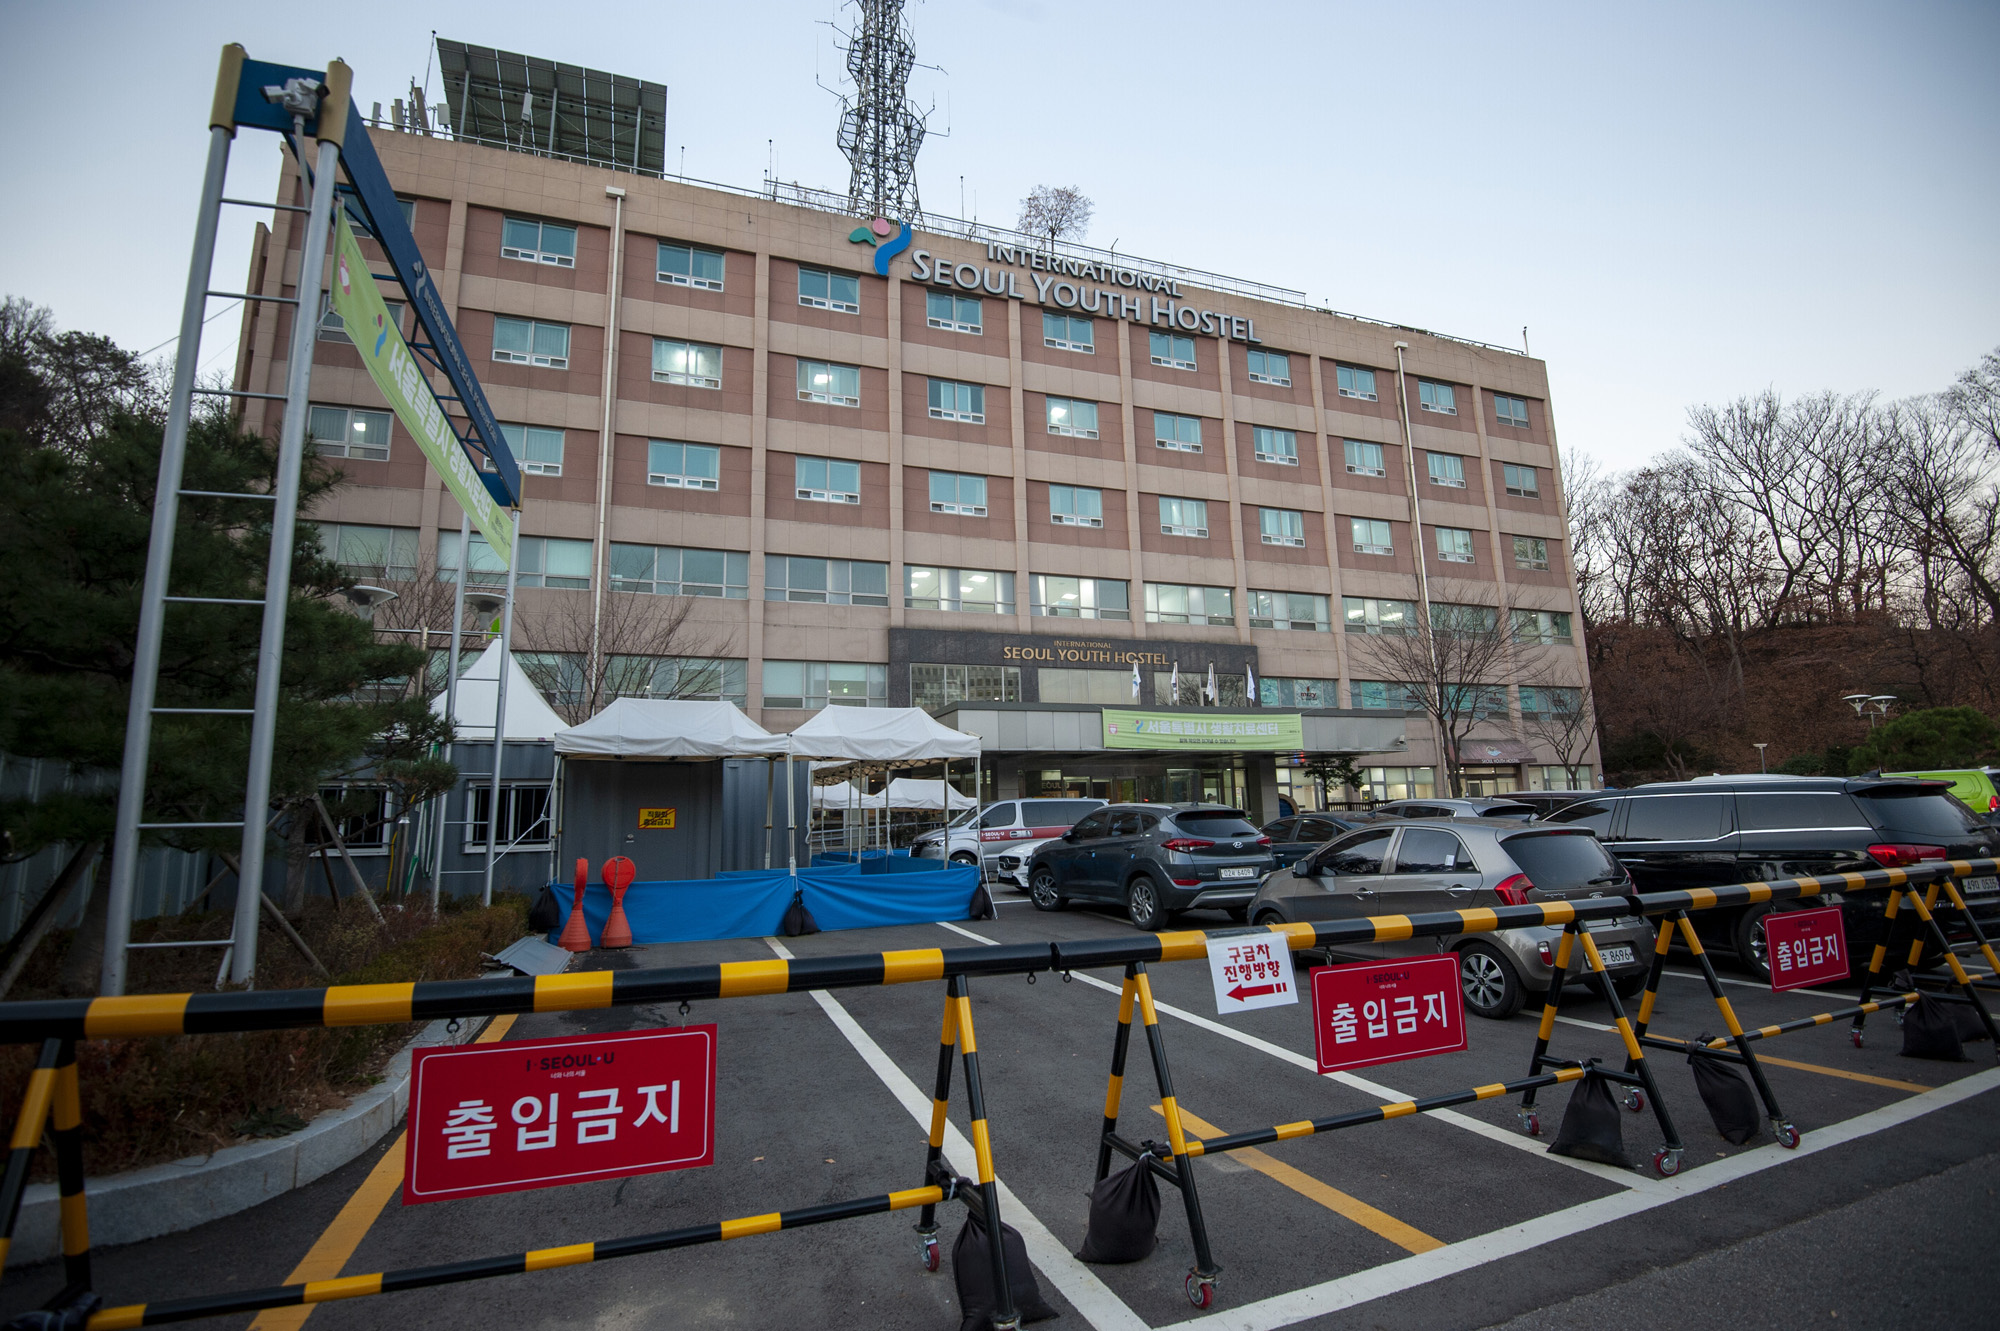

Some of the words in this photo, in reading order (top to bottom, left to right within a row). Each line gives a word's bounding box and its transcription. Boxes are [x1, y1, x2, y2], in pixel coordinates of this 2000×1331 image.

[988, 242, 1183, 298] INTERNATIONAL
[911, 249, 1025, 299] SEOUL
[1030, 273, 1142, 320] YOUTH
[1151, 297, 1262, 344] HOSTEL
[388, 341, 450, 459] 서울특별시
[449, 439, 494, 527] 생활치료센터
[1003, 646, 1055, 661] SEOUL
[1058, 649, 1110, 663] YOUTH
[1114, 652, 1170, 665] HOSTEL
[1053, 640, 1112, 649] INTERNATIONAL
[1147, 720, 1208, 735] 서울특별시
[1210, 721, 1279, 736] 생활치료센터
[1227, 943, 1271, 963] 구급차
[1609, 948, 1630, 963] 8696
[1777, 933, 1839, 972] 출입금지
[1223, 960, 1280, 983] 진행방향
[1330, 991, 1448, 1044] 출입금지
[442, 1079, 681, 1160] 출입금지
